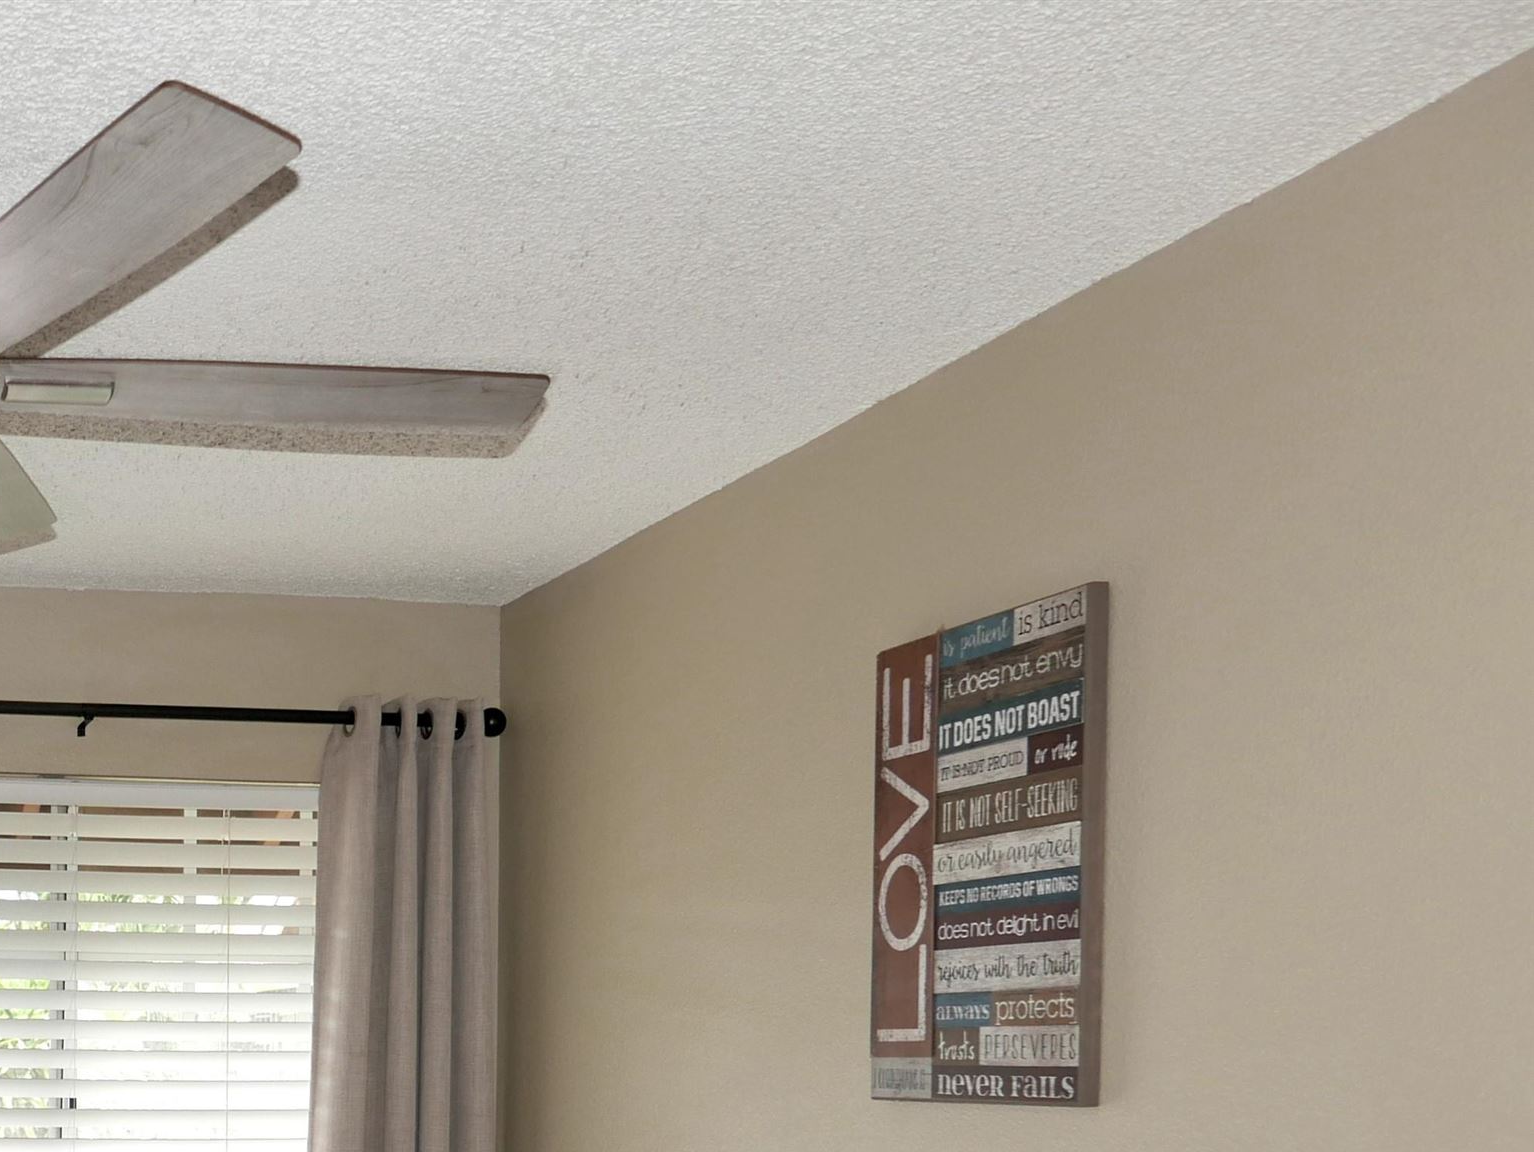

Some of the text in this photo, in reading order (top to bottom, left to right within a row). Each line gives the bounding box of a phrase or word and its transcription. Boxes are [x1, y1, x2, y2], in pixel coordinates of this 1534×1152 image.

[1018, 591, 1084, 636] is kind
[960, 616, 1010, 658] patient
[943, 643, 1083, 700] it does not envy
[939, 690, 1081, 751] IT DOES NOT BOAST
[940, 766, 951, 782] IT
[962, 758, 986, 777] NOT
[987, 750, 1025, 772] PROUD
[1034, 734, 1079, 765] or rude
[942, 777, 1079, 833] IT IS NOT SELF-SEEKING
[877, 654, 933, 1042] LOVE
[937, 828, 1075, 873] or easily angered
[939, 875, 1079, 907] KEEPS NO RECORDS OF WRONGS
[938, 922, 968, 941] does
[970, 917, 995, 938] not
[1042, 912, 1055, 931] in
[938, 951, 1078, 989] rejoices with the truth
[994, 992, 1075, 1026] protects
[938, 1031, 975, 1060] trusts
